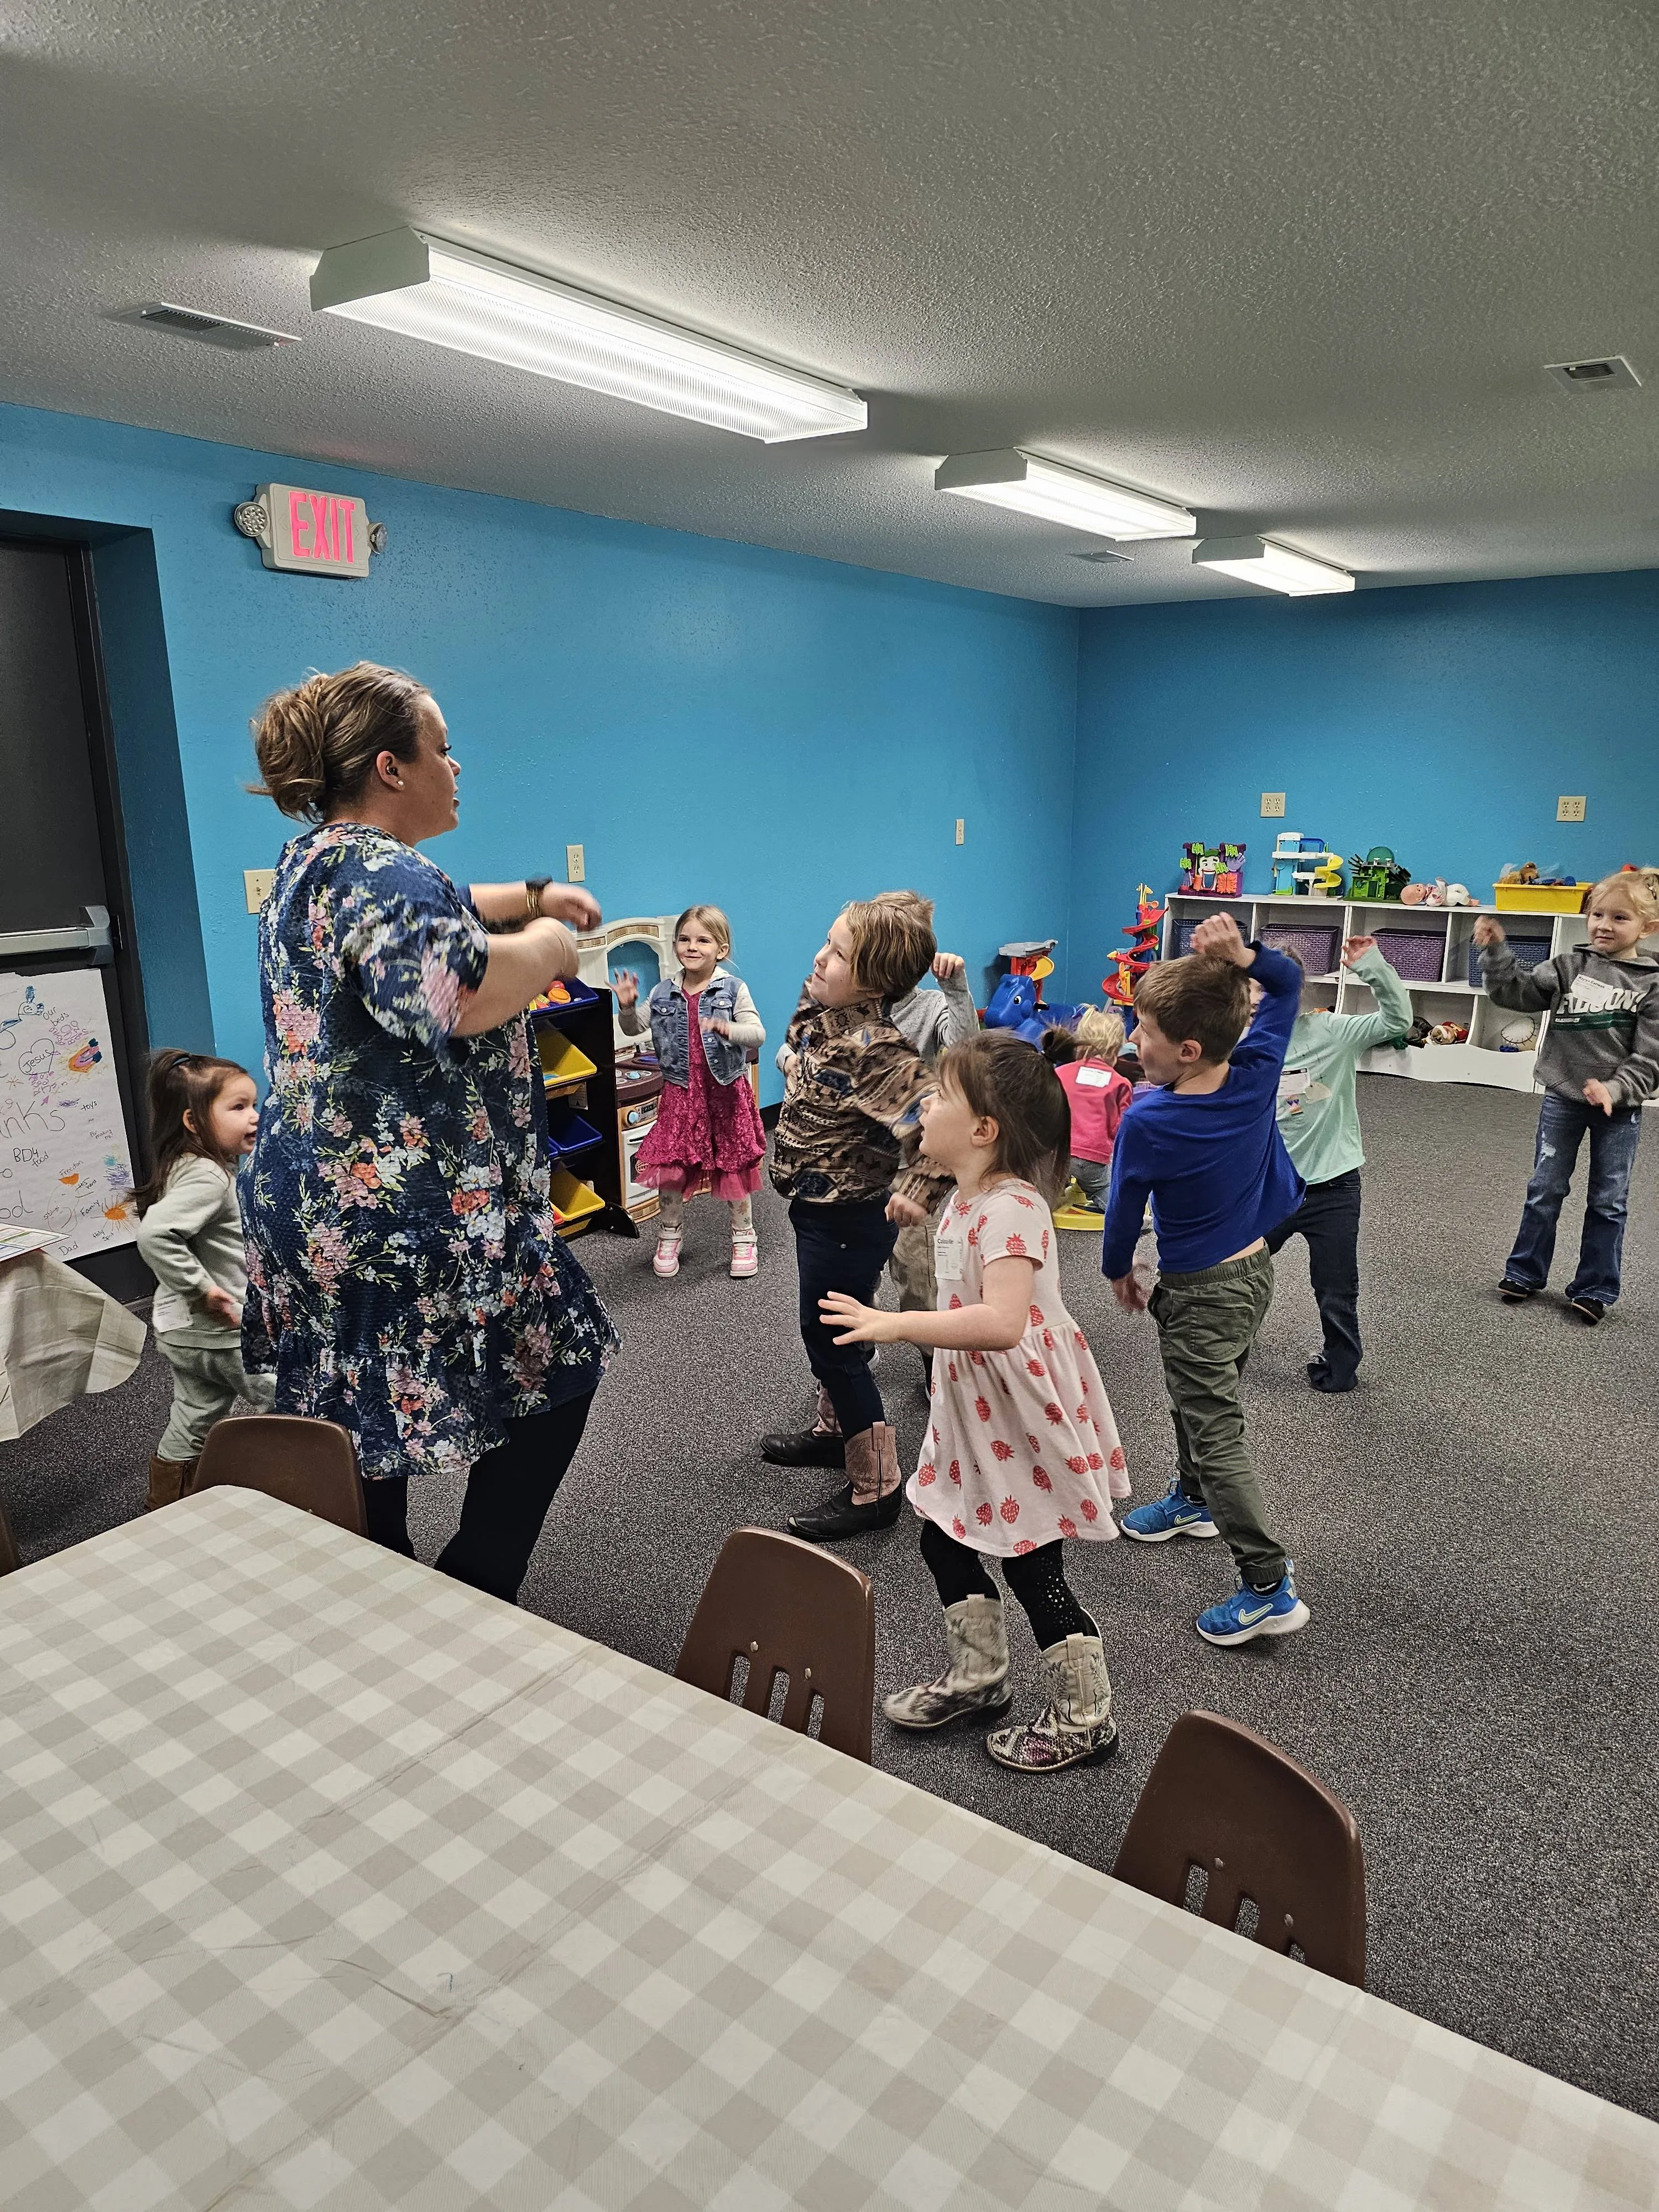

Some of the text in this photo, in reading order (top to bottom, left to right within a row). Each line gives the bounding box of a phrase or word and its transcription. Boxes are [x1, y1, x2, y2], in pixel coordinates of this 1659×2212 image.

[289, 491, 355, 564] EXIT
[1192, 842, 1204, 855] HA
[1225, 844, 1238, 857] HA
[1180, 858, 1192, 870] HA
[1215, 862, 1229, 874] HA
[50, 1013, 70, 1026] beds
[23, 1049, 52, 1073] Jesus
[81, 1101, 97, 1111] toys
[32, 1151, 49, 1167] food
[80, 1199, 100, 1217] Family
[92, 1229, 106, 1238] Holy
[58, 1240, 78, 1256] Dad
